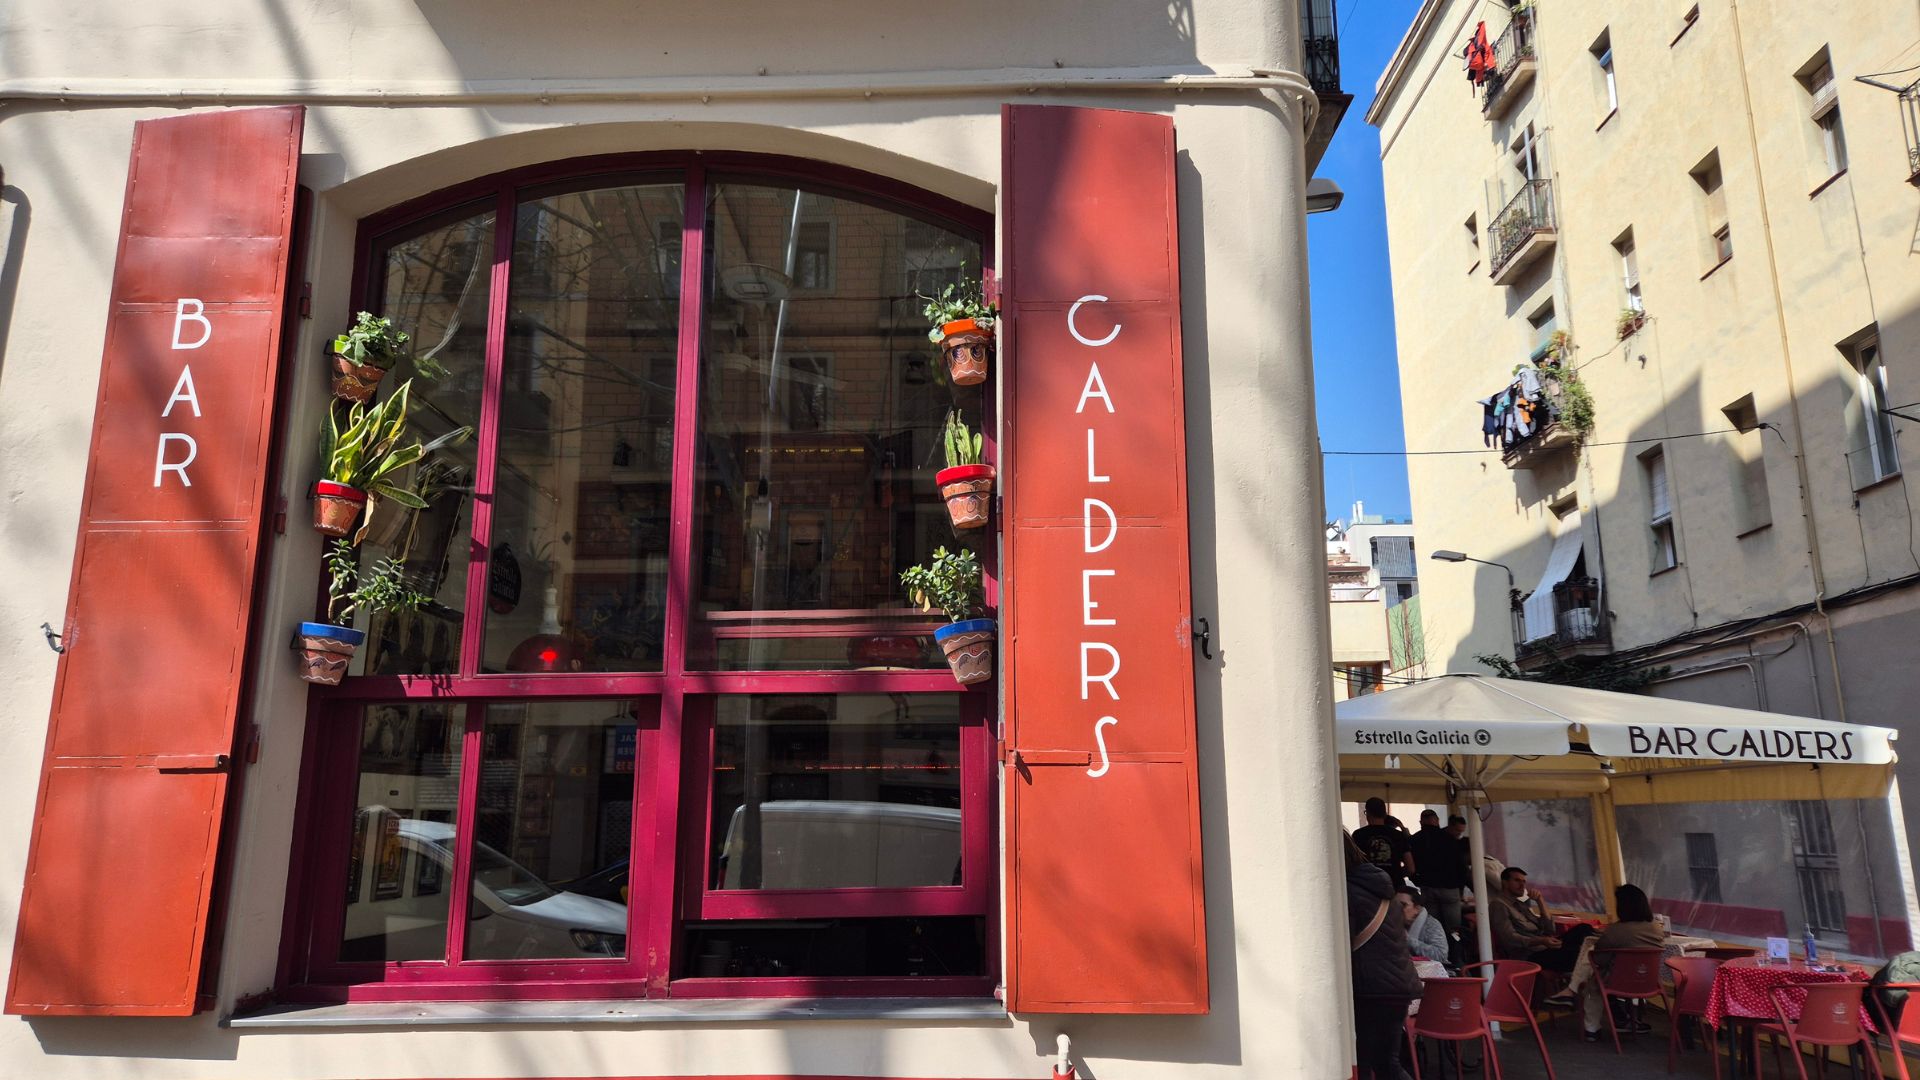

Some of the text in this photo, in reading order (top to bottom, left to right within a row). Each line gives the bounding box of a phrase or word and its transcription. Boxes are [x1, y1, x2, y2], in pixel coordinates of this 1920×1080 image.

[154, 298, 212, 487] BAR
[1067, 294, 1122, 778] CALDERS
[1354, 730, 1470, 745] Estrella Galicia
[1628, 726, 1852, 760] BAR CALDERS
